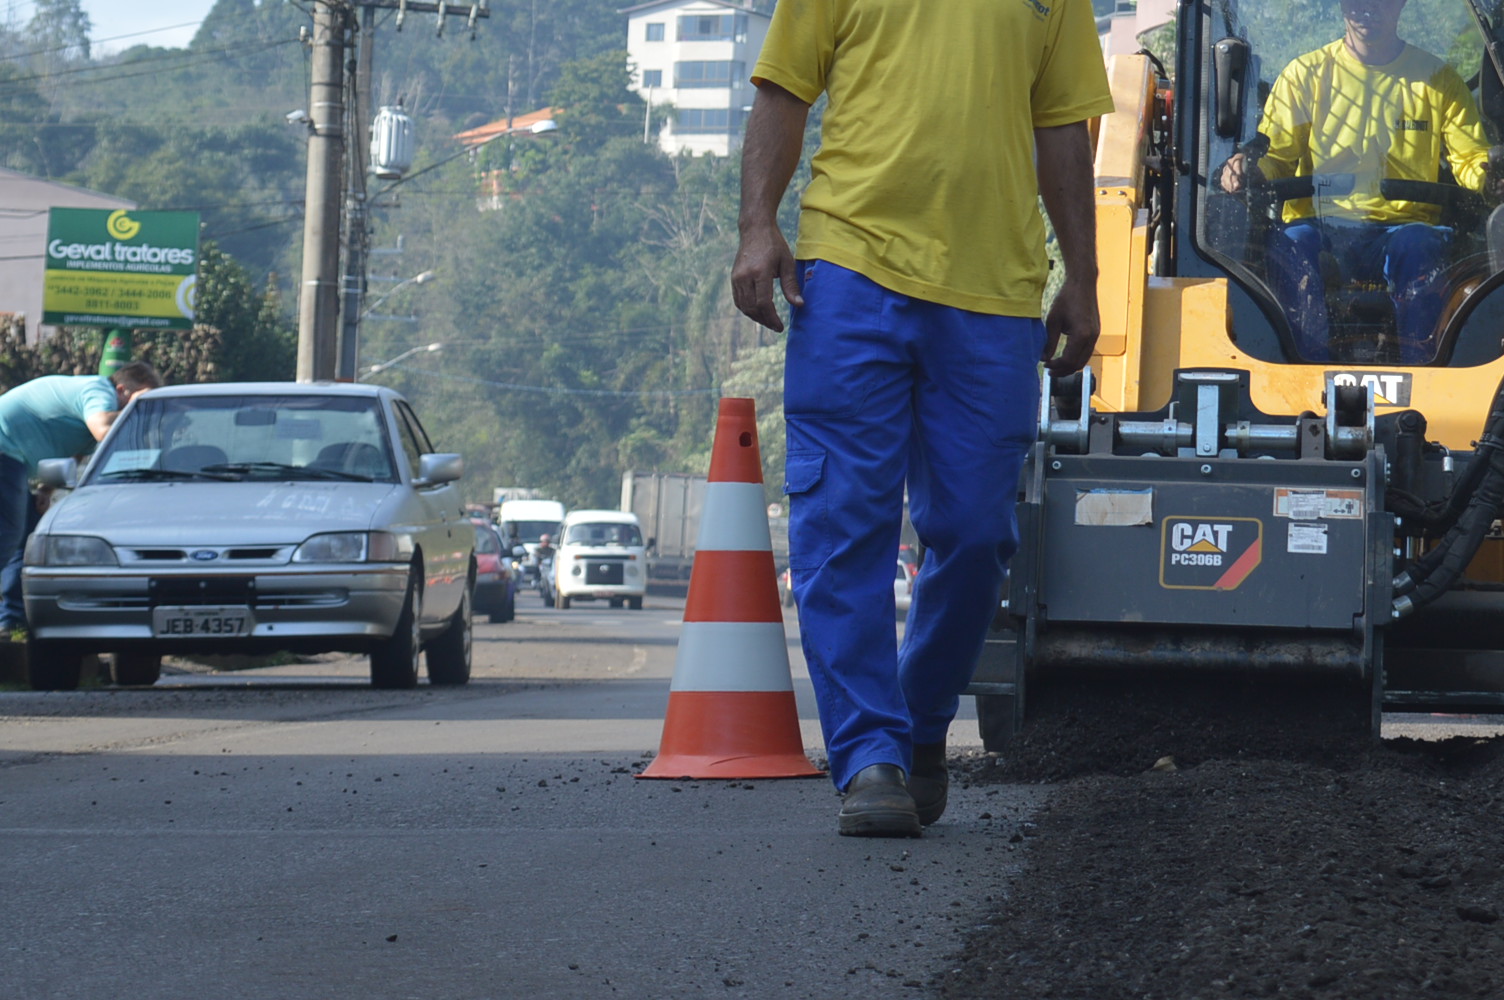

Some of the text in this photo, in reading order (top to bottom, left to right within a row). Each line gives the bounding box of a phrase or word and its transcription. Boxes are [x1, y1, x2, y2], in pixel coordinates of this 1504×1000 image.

[48, 239, 195, 264] Geval tratores
[66, 260, 125, 272] IMPLEMENTOS
[1171, 522, 1233, 553] CAT
[1171, 553, 1223, 567] PC306B
